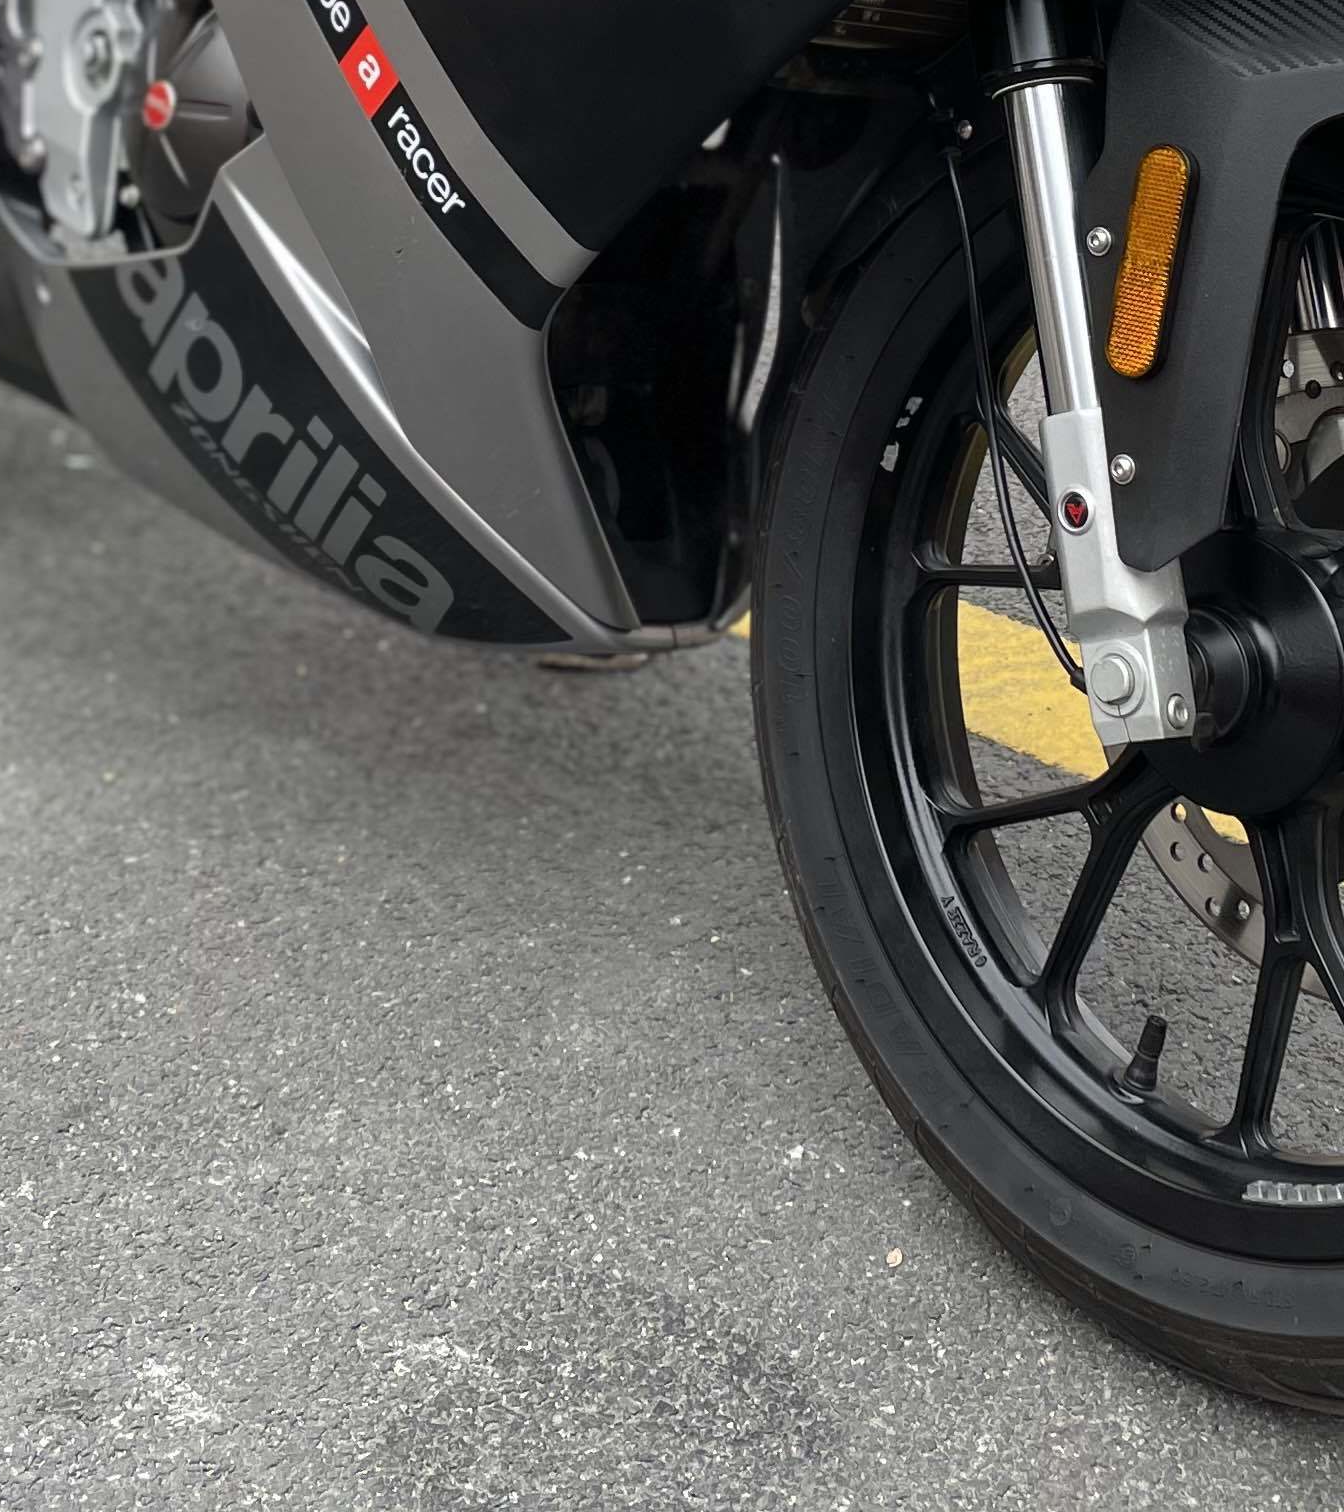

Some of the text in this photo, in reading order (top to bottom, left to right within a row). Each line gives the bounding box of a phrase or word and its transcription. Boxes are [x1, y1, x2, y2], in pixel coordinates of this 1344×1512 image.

[356, 53, 382, 89] a
[386, 104, 467, 215] racer
[119, 257, 455, 634] aprilia
